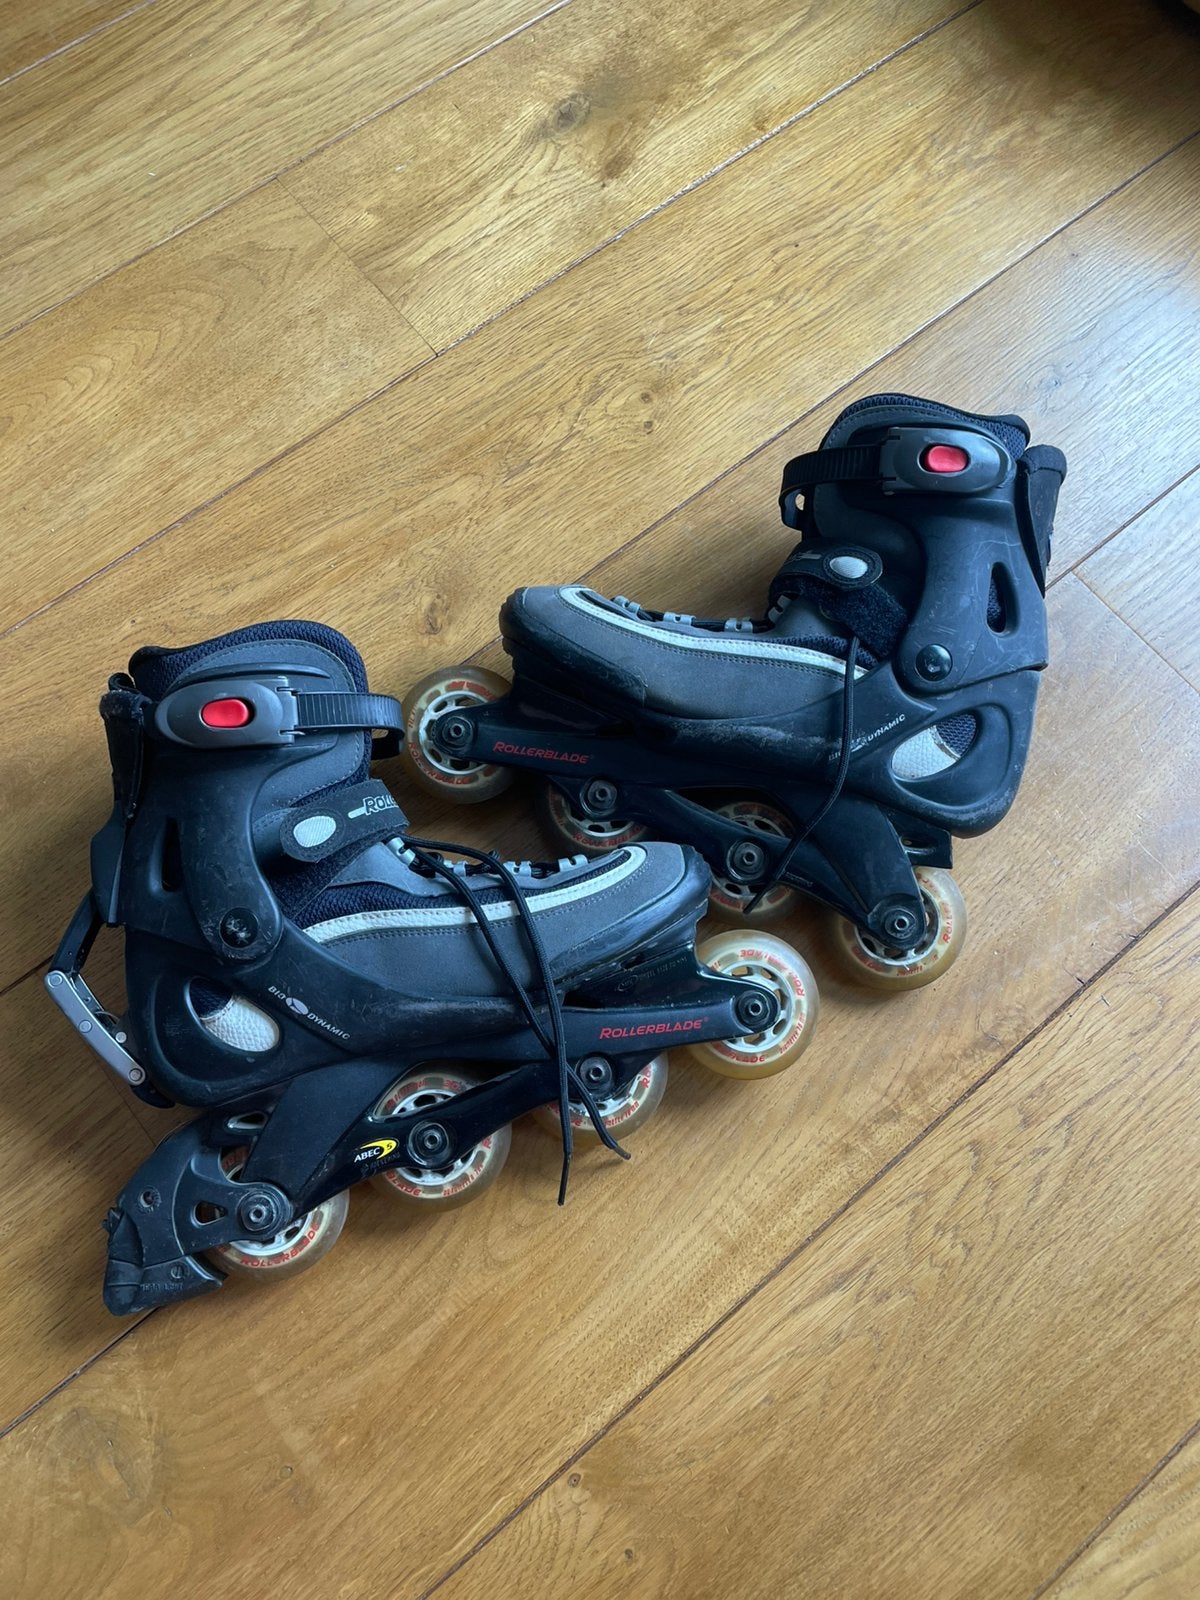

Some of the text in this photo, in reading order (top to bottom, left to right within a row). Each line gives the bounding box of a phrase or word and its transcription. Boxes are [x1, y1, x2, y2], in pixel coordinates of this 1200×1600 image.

[363, 795, 399, 815] ROLL
[267, 985, 351, 1040] BIO DYNAMIC
[354, 1147, 381, 1163] ABEC
[240, 1221, 320, 1268] ROLLERBLADE
